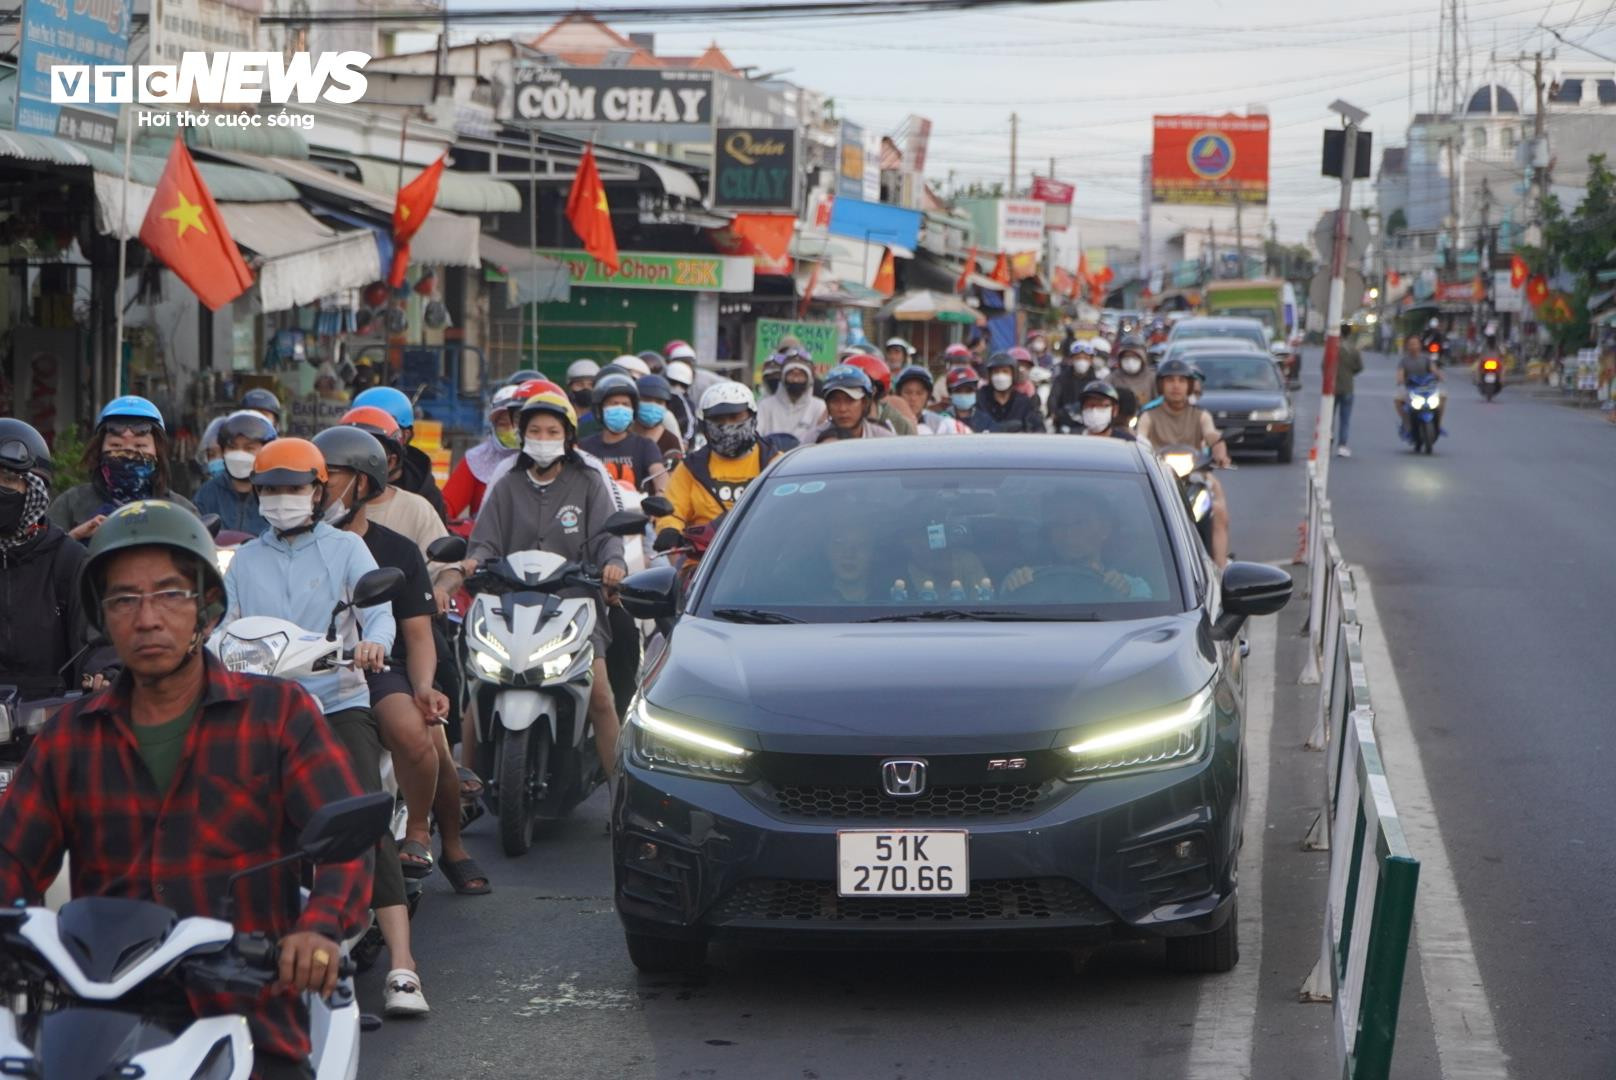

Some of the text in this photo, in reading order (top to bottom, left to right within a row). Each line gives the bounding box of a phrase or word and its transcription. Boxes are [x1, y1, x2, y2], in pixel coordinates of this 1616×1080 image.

[518, 80, 597, 121] CƠM
[602, 86, 706, 122] CHAY
[725, 131, 785, 165] Quán
[721, 167, 788, 199] CHAY
[676, 259, 719, 287] 25K
[987, 758, 1027, 770] RS
[876, 835, 929, 861] 51K
[854, 865, 953, 892] 270.66
